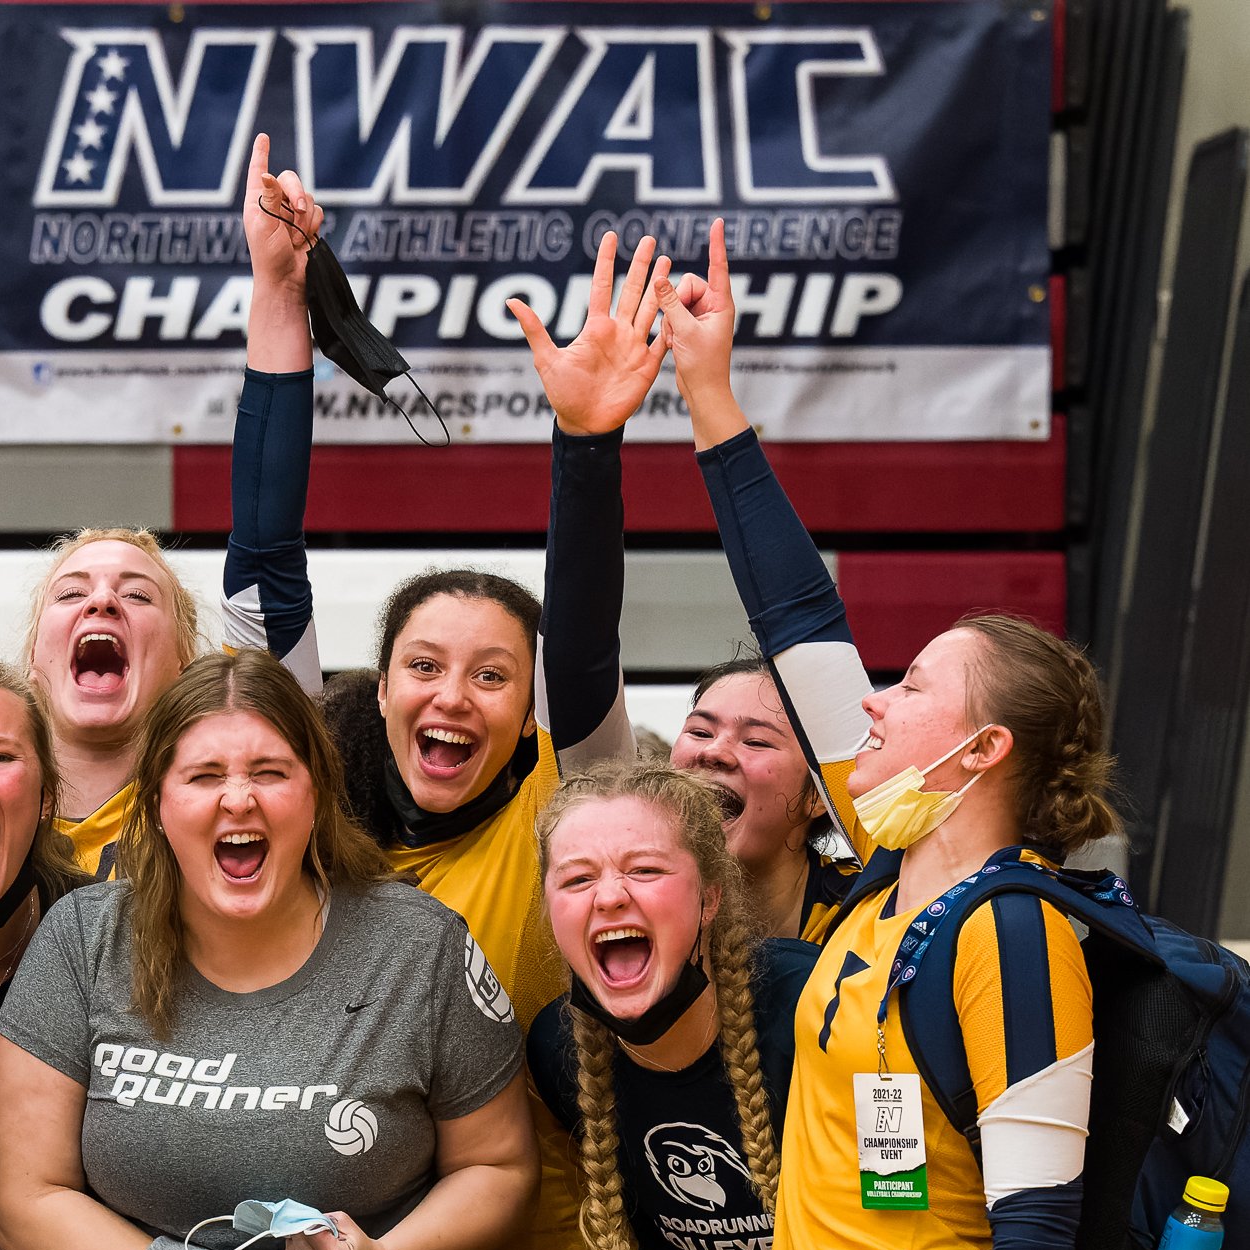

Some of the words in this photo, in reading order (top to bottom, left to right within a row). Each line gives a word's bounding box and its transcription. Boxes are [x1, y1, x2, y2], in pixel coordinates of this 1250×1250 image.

[33, 26, 899, 207] NWAC
[30, 212, 337, 264] NORTHW
[339, 209, 575, 262] ATHLETIC
[872, 1088, 902, 1100] 2021-22
[863, 1137, 919, 1149] CHAMPIONSHIP
[880, 1149, 903, 1160] EVENT
[873, 1180, 914, 1191] PARTICIPANT
